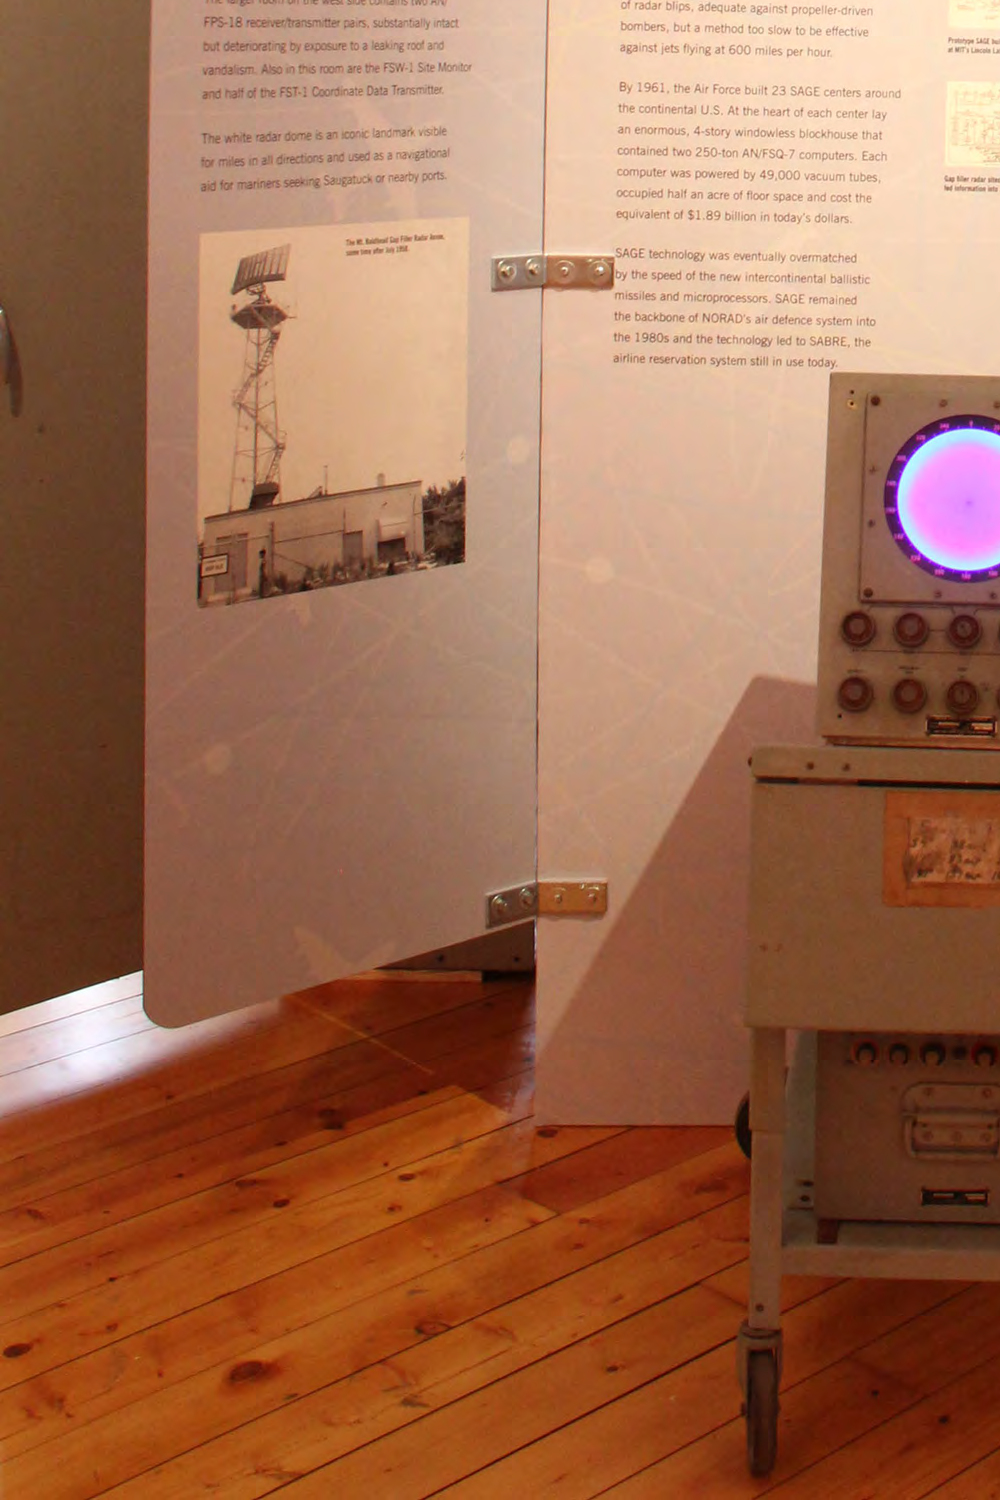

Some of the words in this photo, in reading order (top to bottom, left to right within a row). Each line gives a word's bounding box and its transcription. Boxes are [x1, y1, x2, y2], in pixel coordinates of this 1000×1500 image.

[203, 16, 243, 28] FPS-18
[246, 17, 340, 28] receiver/transmitter
[373, 17, 430, 30] substantially
[433, 18, 459, 28] intact
[947, 37, 974, 45] Prototype
[619, 81, 633, 94] By
[637, 81, 669, 94] 1961,
[673, 83, 690, 93] the
[693, 83, 709, 94] Air
[712, 83, 741, 95] Force
[744, 85, 768, 95] built
[771, 85, 786, 96] 23
[790, 85, 820, 97] SAGE
[823, 88, 861, 98] centers
[865, 89, 901, 98] around
[615, 247, 646, 259] SAGE
[648, 249, 705, 262] technology
[708, 252, 729, 260] was
[733, 251, 786, 264] eventually
[789, 252, 857, 263] overmatched
